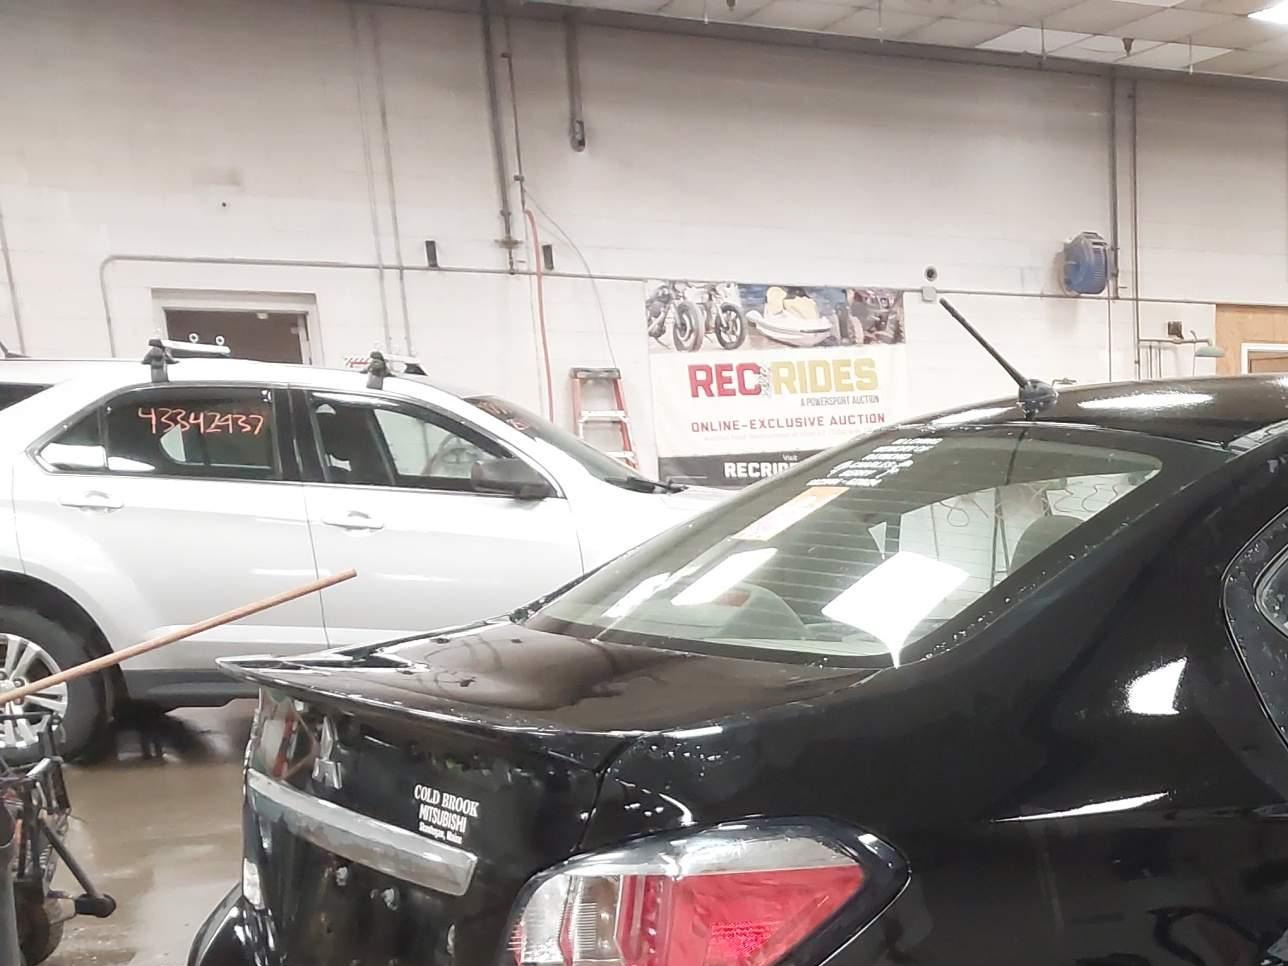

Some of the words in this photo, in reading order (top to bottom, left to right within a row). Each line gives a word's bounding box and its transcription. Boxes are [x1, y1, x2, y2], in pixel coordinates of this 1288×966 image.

[688, 362, 762, 398] REC
[769, 358, 880, 397] RIDES
[806, 396, 850, 407] POWERSPORT
[852, 394, 881, 405] AUCTION
[691, 416, 825, 433] ONLINE-EXCLUSIVE
[829, 412, 886, 426] AUCTION
[782, 454, 798, 462] Visit
[414, 784, 441, 804] COLD
[441, 792, 480, 817] BROOK
[419, 803, 467, 833] MITSUBISHI
